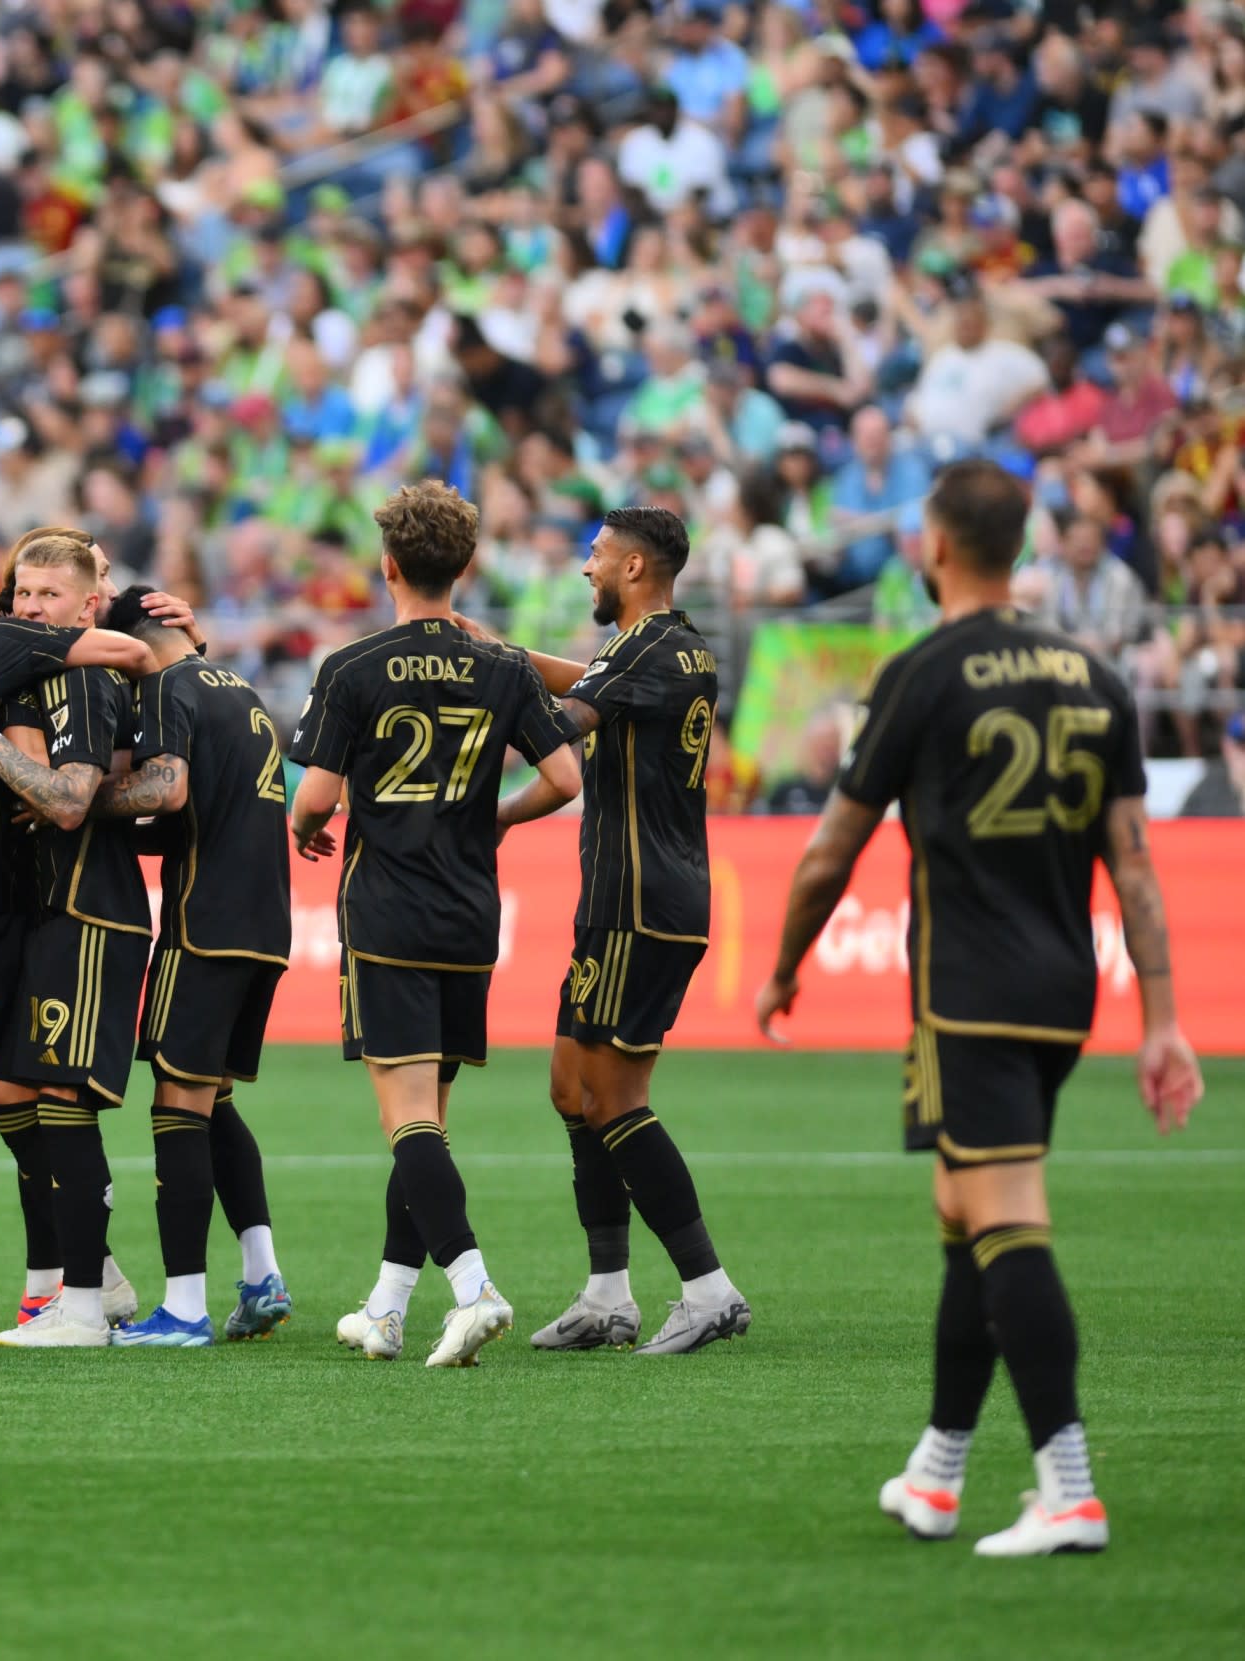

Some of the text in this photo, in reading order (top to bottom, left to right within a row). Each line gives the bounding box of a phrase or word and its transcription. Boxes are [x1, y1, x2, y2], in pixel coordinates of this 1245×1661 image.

[387, 655, 475, 683] ORDAZ
[374, 704, 494, 803] 27
[967, 705, 1112, 838] 25
[29, 995, 70, 1046] 19
